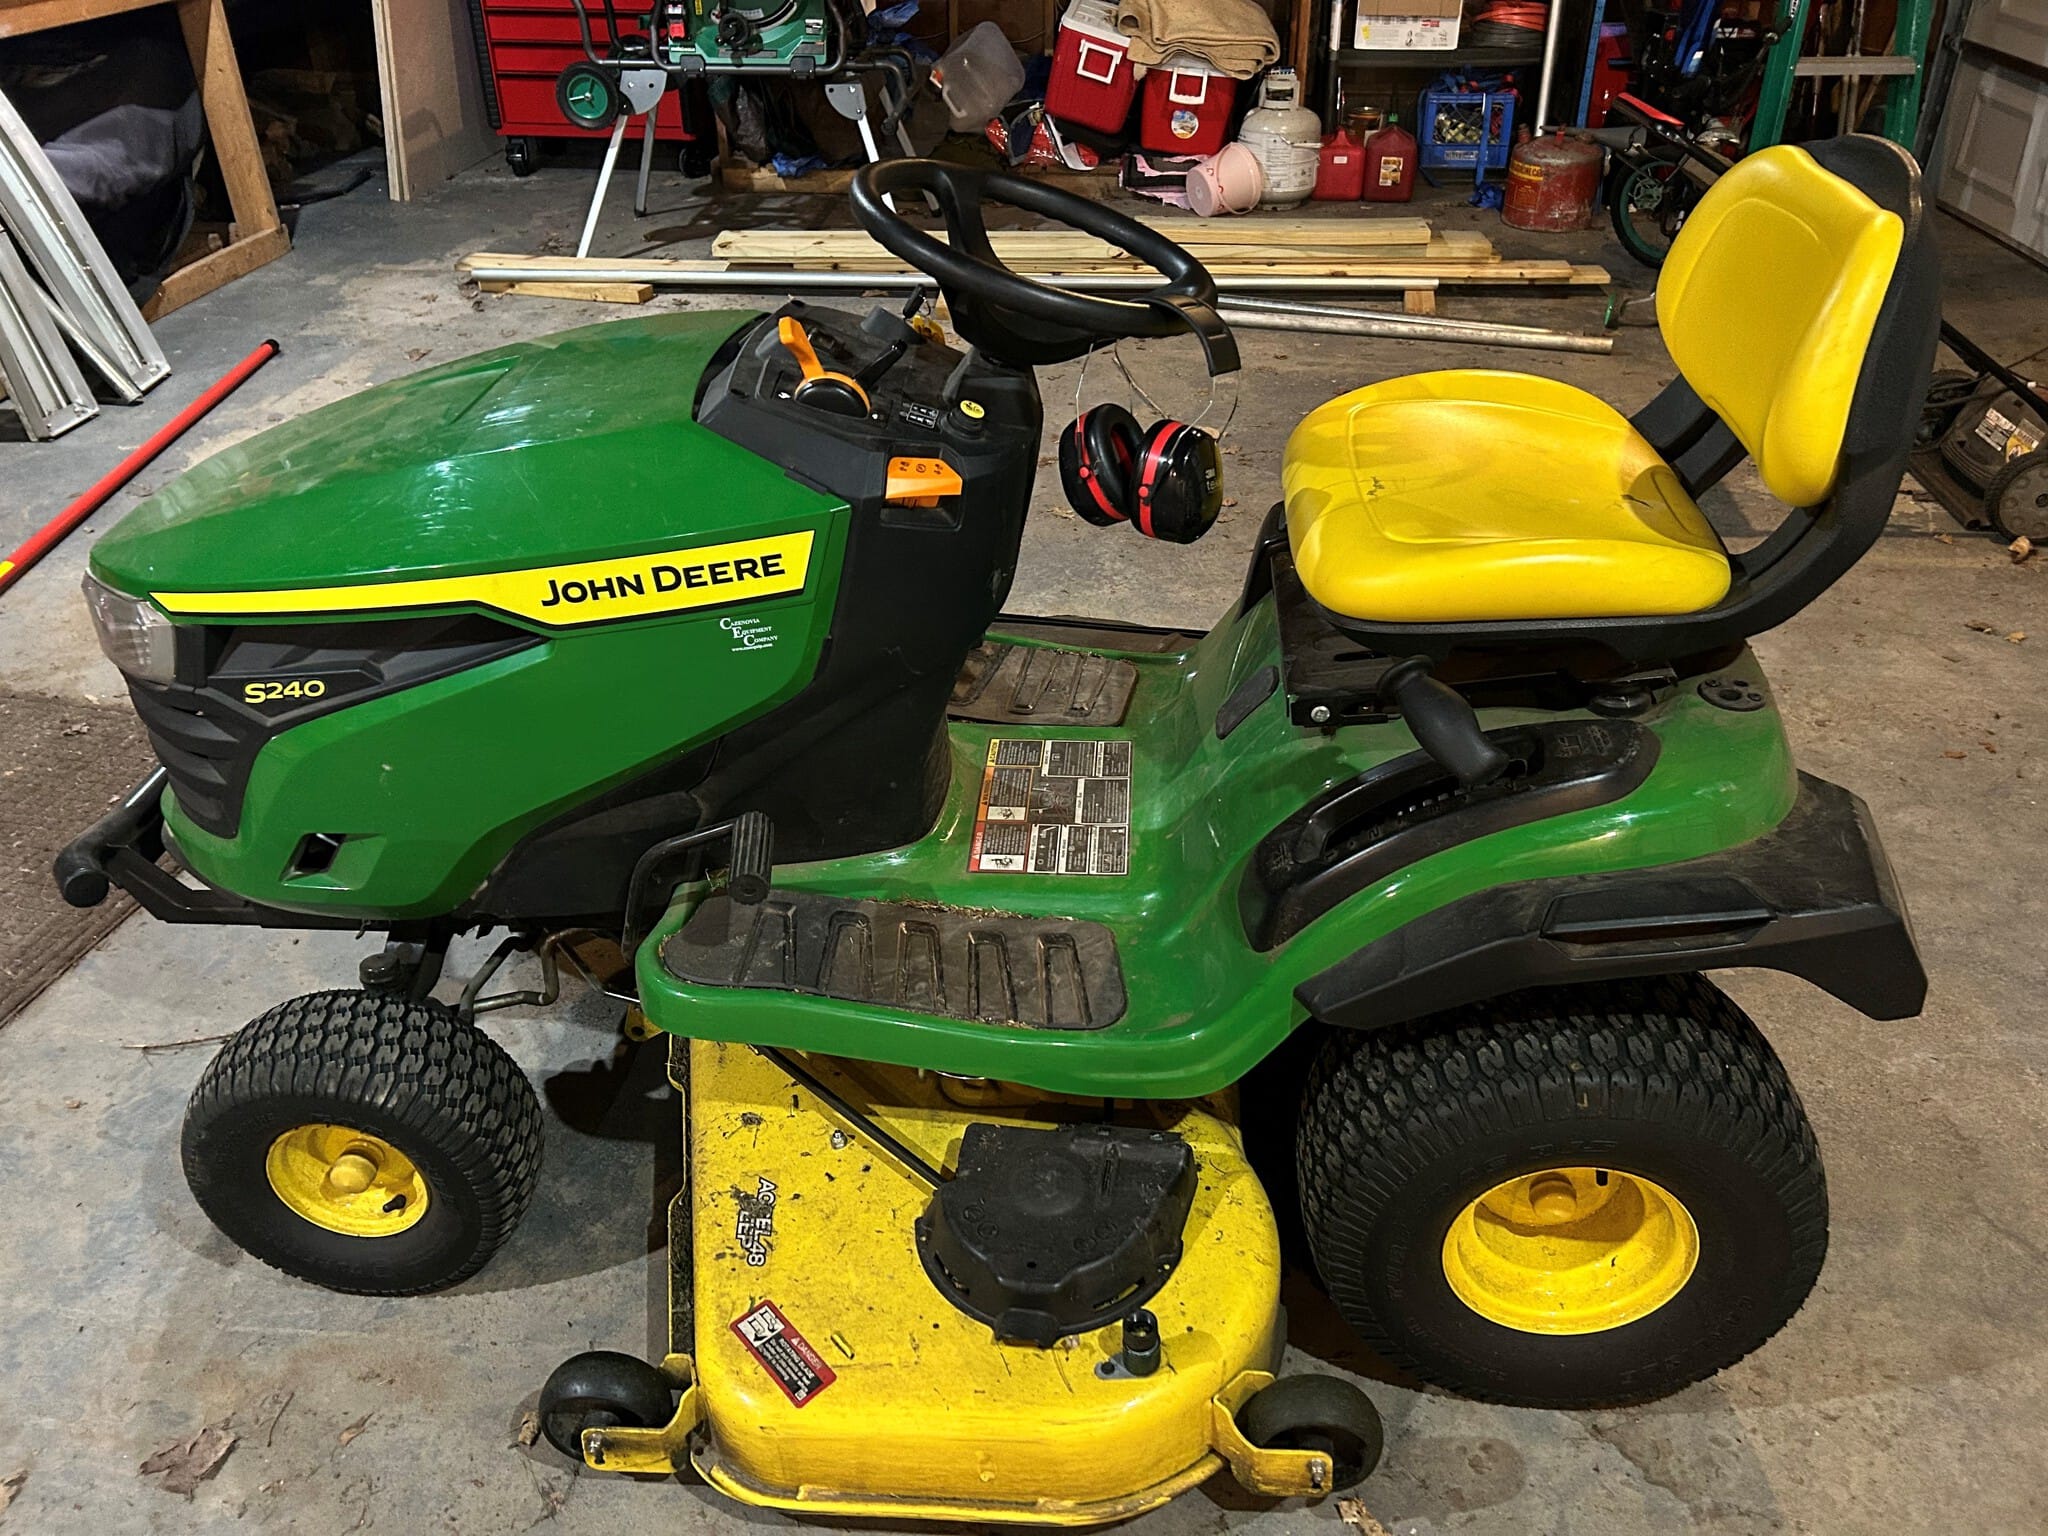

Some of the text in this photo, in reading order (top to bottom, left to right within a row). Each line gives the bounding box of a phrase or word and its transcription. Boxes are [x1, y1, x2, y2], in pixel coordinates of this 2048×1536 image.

[541, 553, 786, 607] JOHN DEERE
[719, 617, 760, 630] CAZENOVIA
[732, 626, 772, 639] EQUIPMENT
[743, 634, 778, 647] COMPANY
[244, 679, 326, 704] S240
[989, 742, 998, 759] CAUTION
[778, 1338, 815, 1379] ROTATING BLADE
[798, 1342, 823, 1369] DANGER
